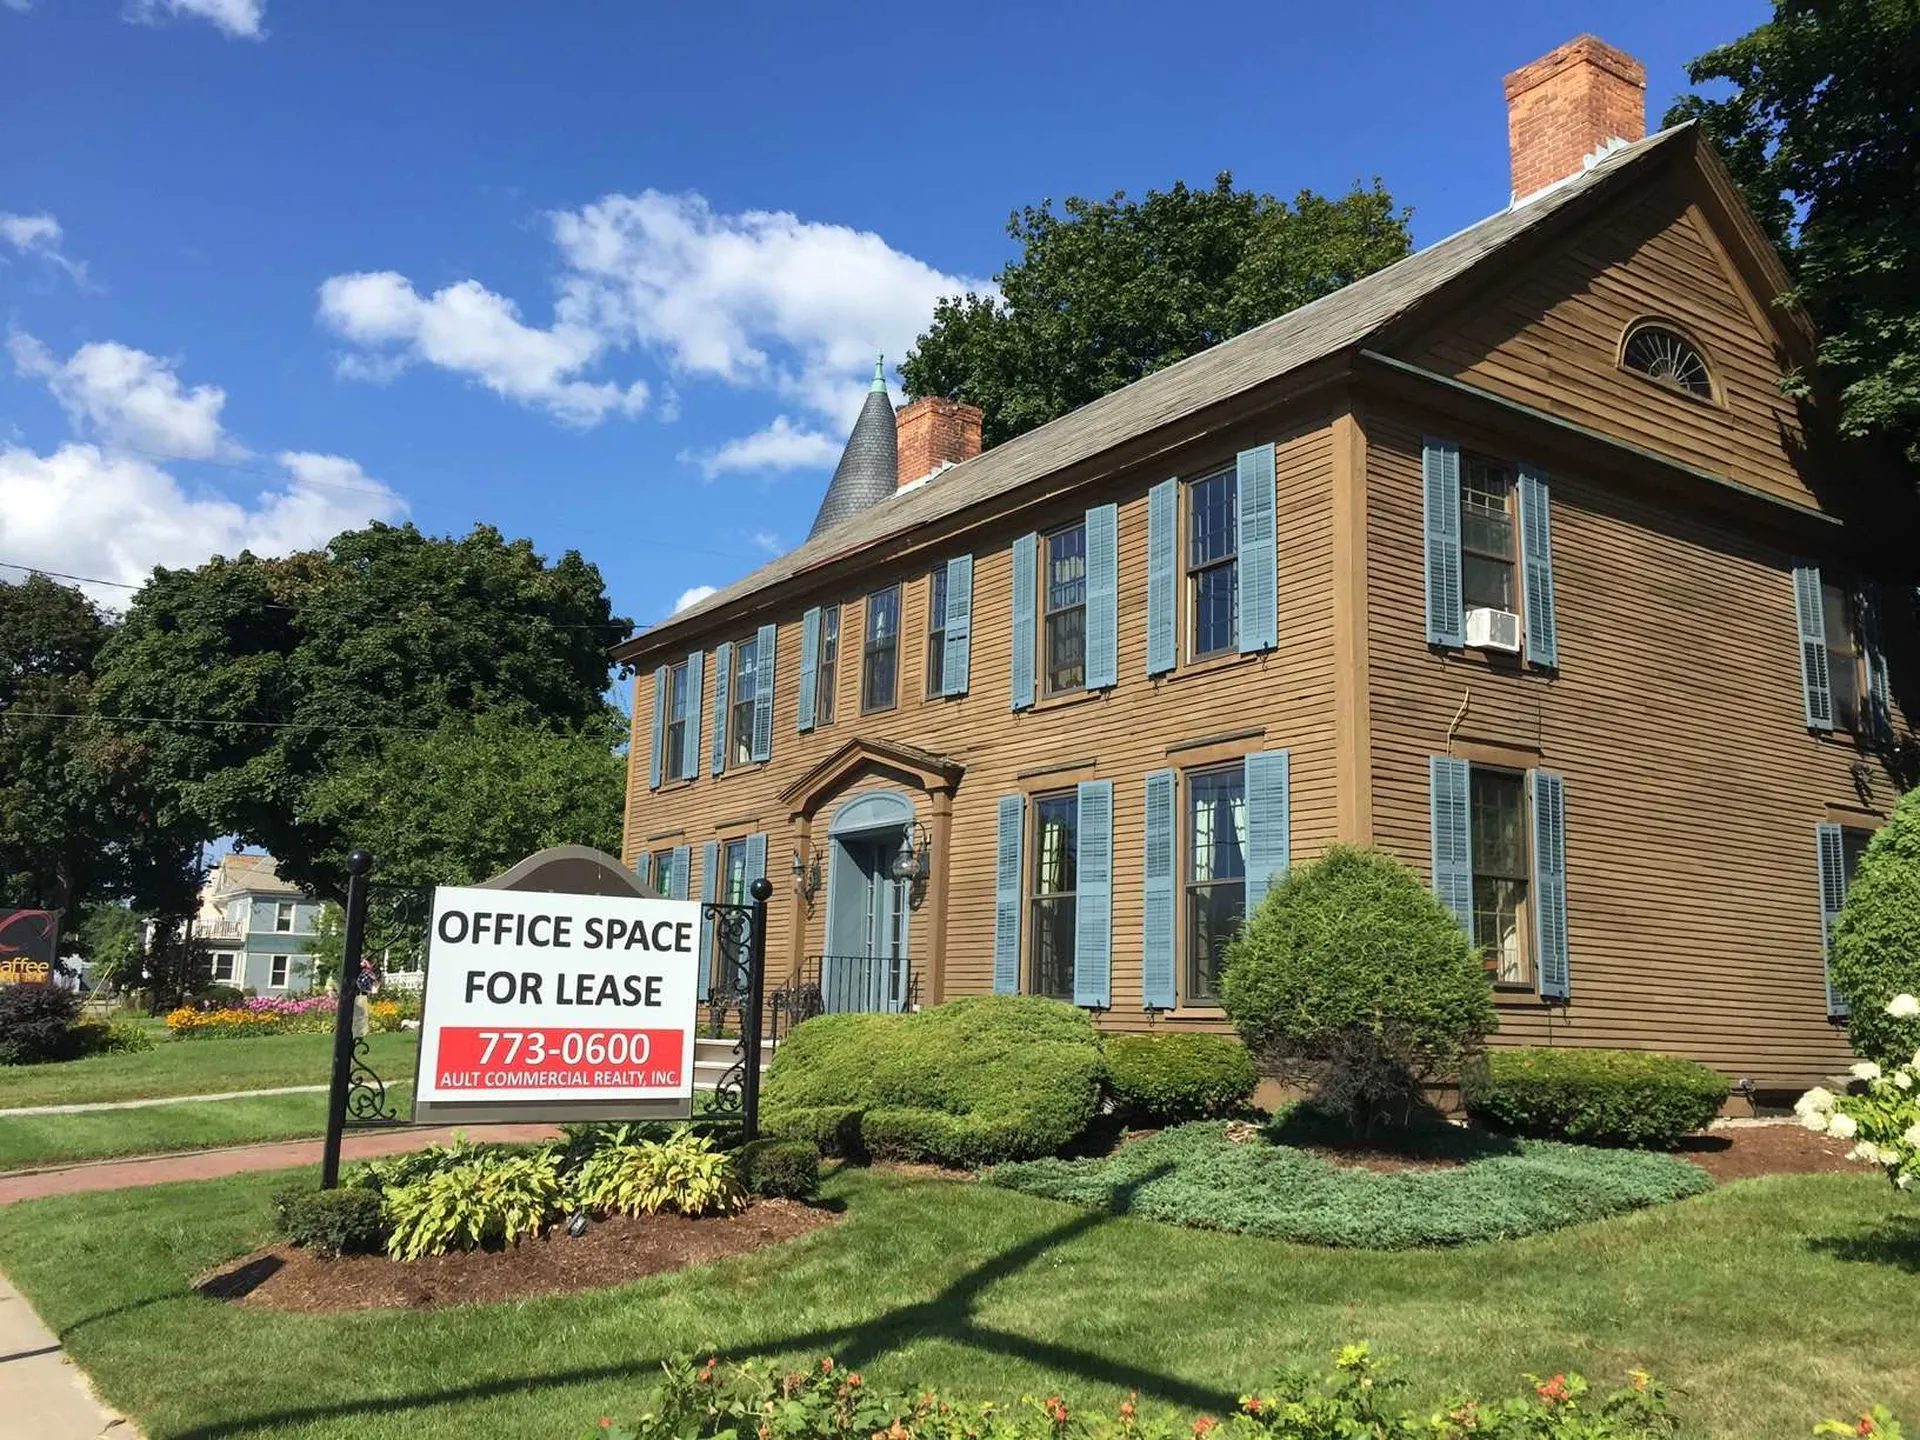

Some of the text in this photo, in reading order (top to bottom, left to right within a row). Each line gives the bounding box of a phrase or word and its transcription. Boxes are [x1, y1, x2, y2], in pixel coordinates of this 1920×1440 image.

[438, 910, 693, 952] OFFICE SPACE
[0, 957, 49, 974] affee
[465, 971, 663, 1007] FOR LEASE
[478, 1032, 651, 1065] 773-0600
[440, 1070, 680, 1087] AULT COMMERCIAL REALTY, INC.
